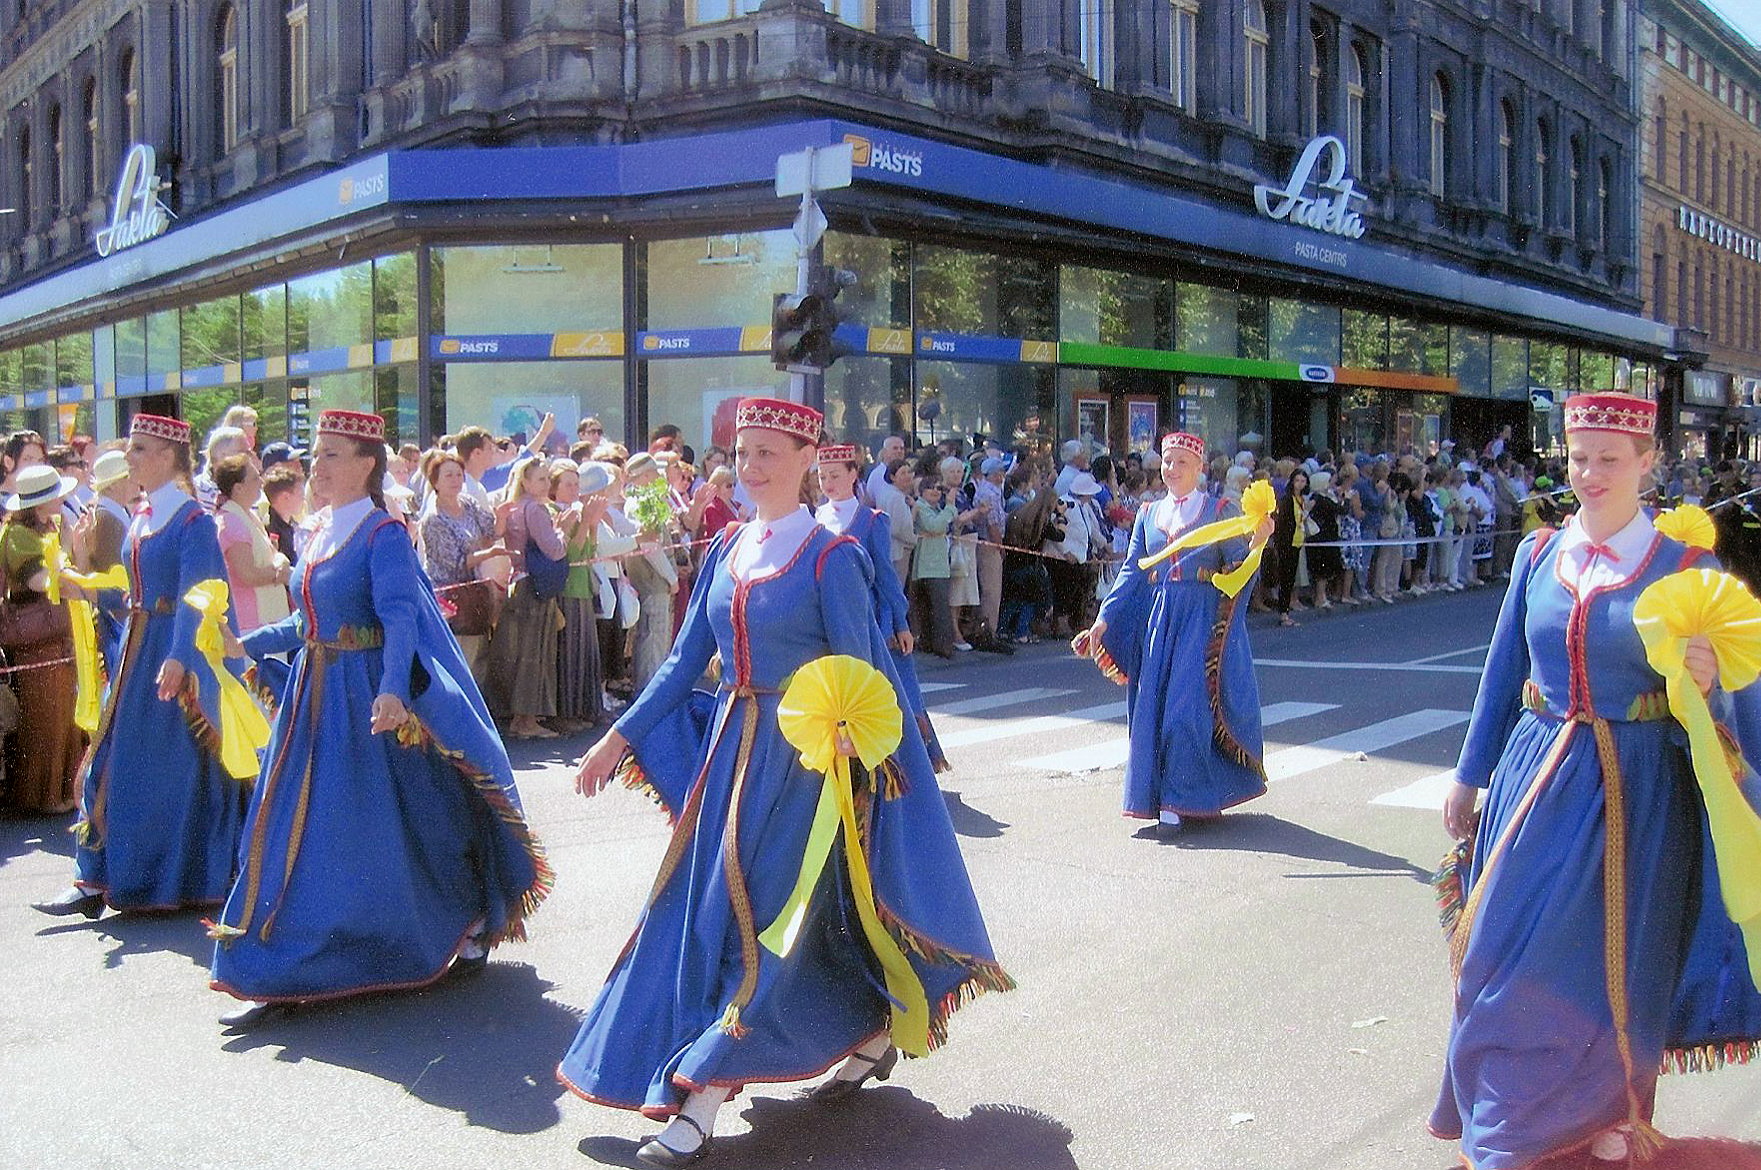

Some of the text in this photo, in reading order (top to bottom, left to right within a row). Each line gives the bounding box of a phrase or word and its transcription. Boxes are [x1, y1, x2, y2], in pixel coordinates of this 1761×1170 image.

[871, 148, 922, 177] PASTS
[353, 174, 384, 200] PASTS
[1295, 241, 1348, 268] PASTA CENTRS
[459, 341, 499, 353] PASTS
[658, 338, 690, 349] PASTS
[932, 341, 956, 352] PASTS
